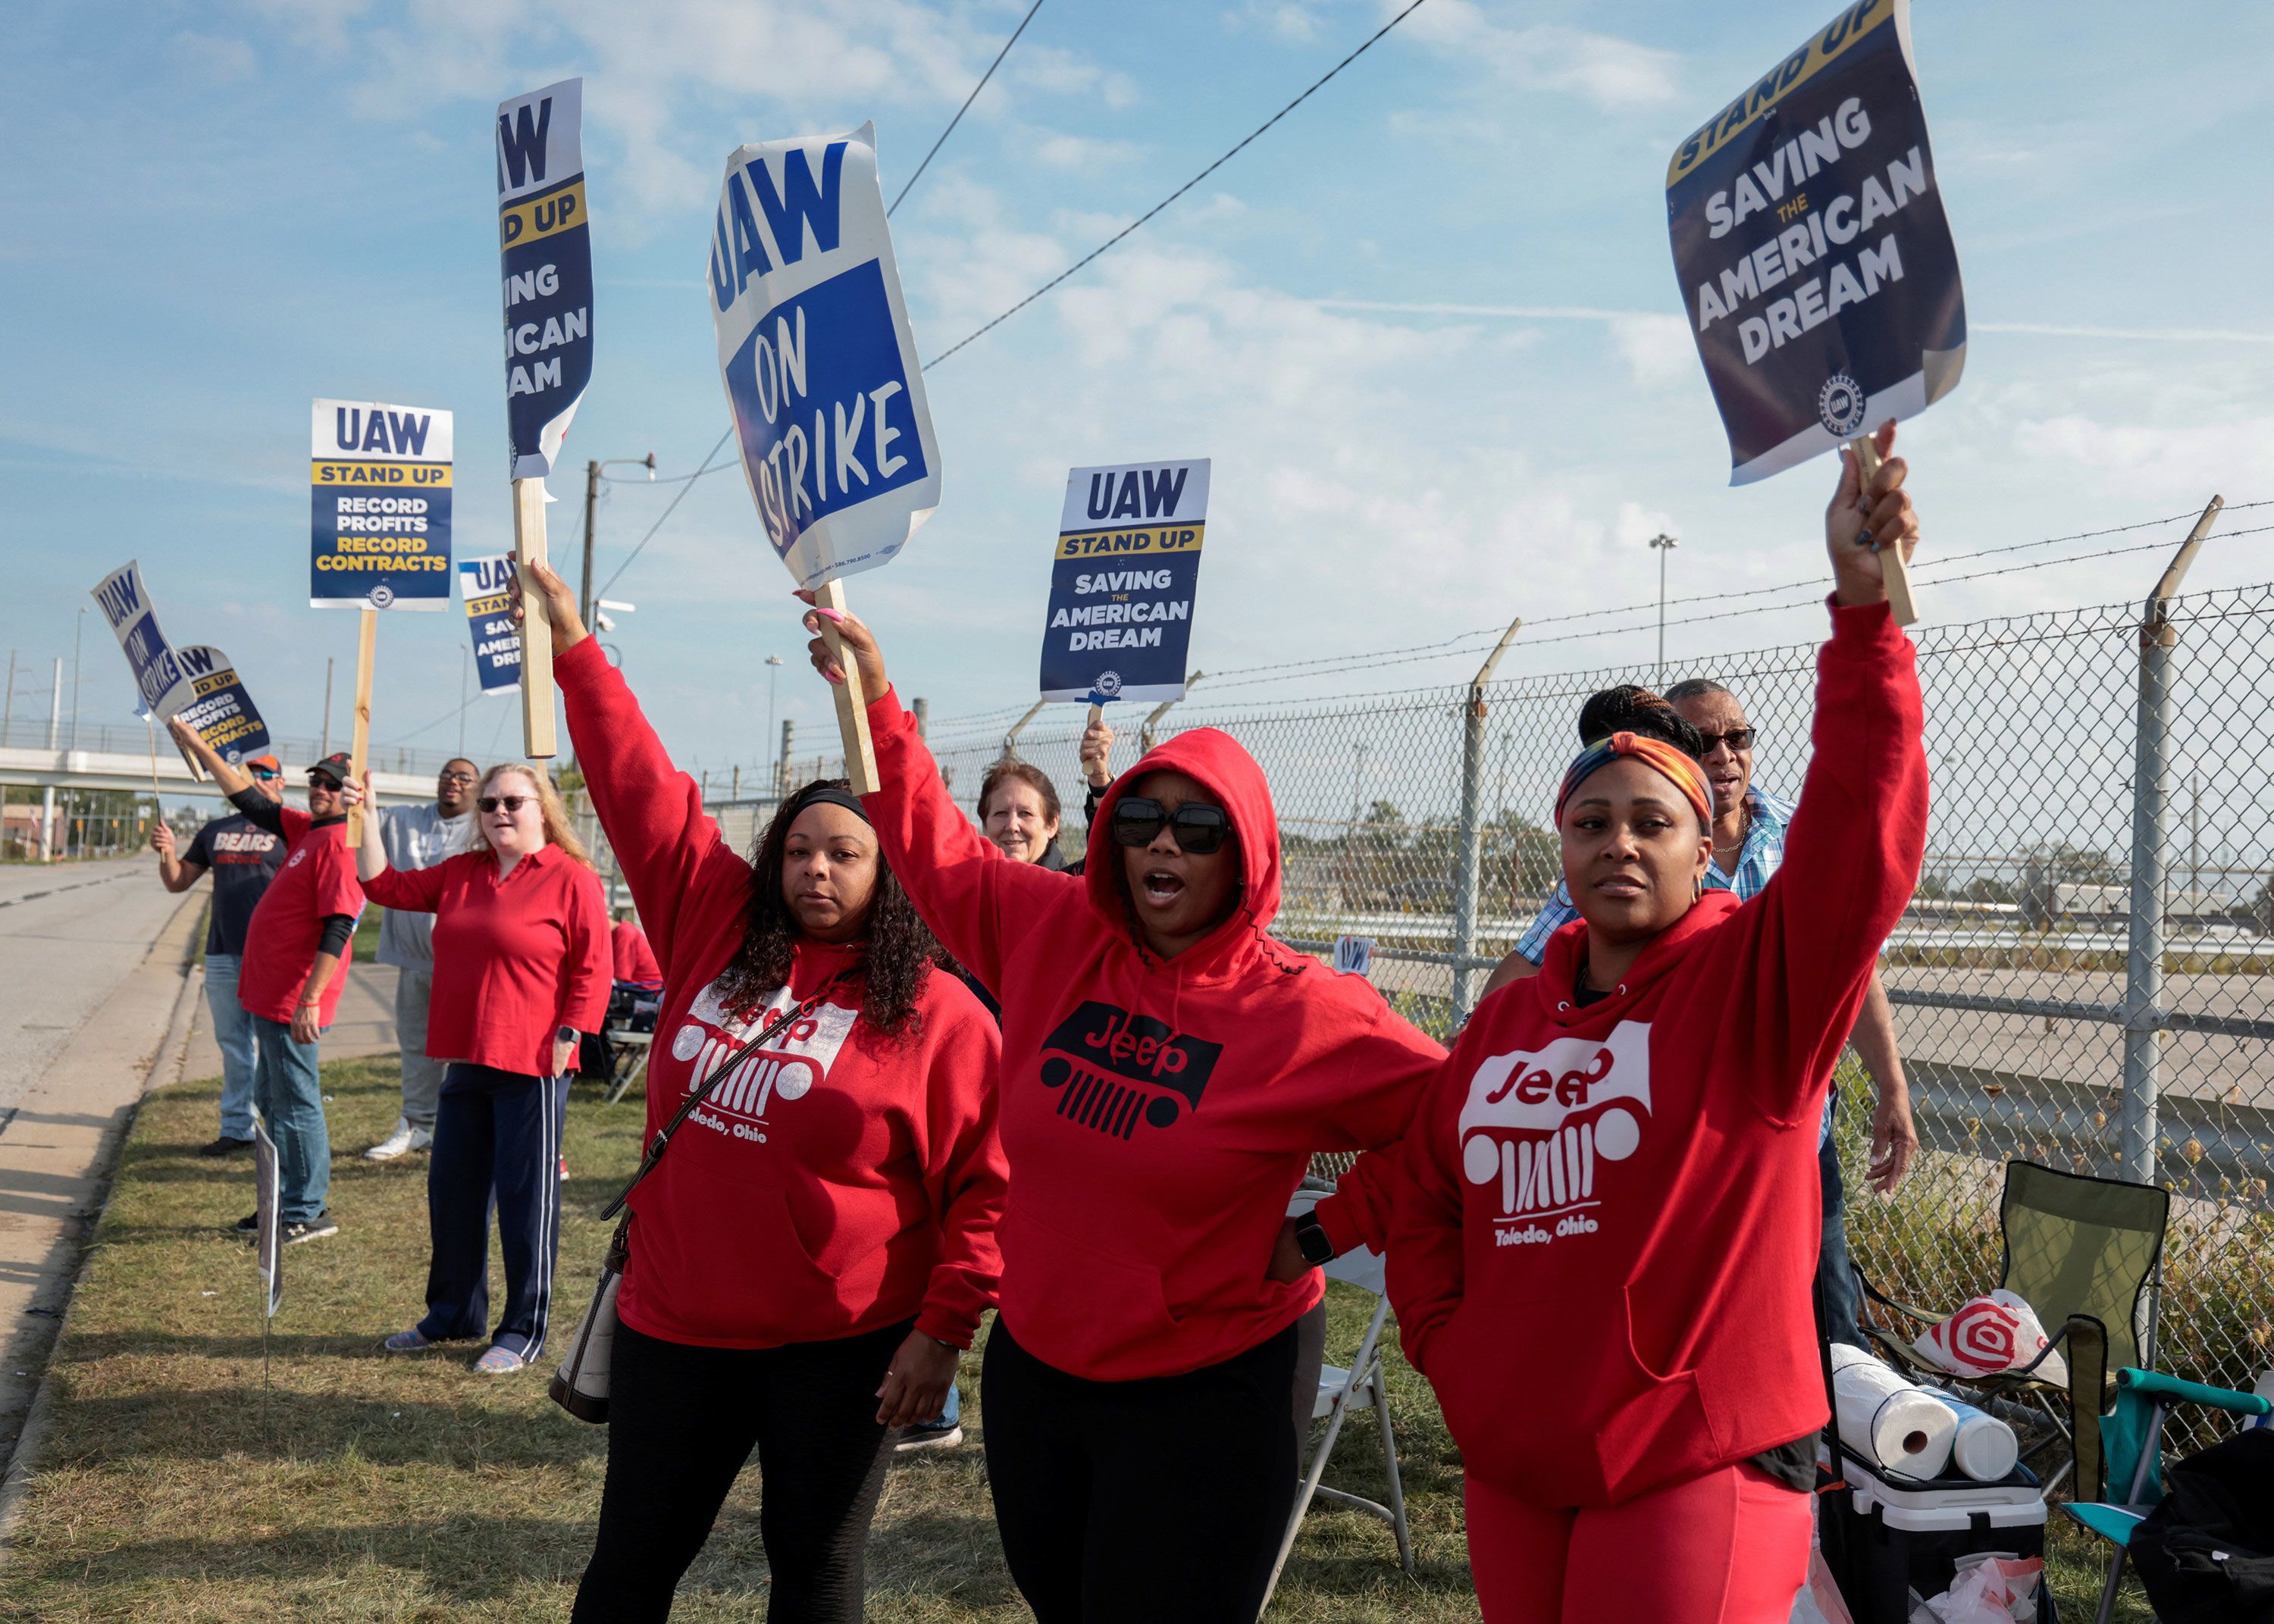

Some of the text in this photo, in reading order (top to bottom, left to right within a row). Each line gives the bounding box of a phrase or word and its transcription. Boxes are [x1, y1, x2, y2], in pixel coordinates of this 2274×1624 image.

[1677, 0, 1878, 171] STAND UP
[499, 96, 553, 194] W
[1705, 97, 1872, 239] SAVING
[534, 193, 576, 233] UP
[712, 142, 848, 313] UAW
[1777, 192, 1809, 224] THE
[1699, 146, 1928, 332] AMERICAN
[1737, 233, 1905, 366] DREAM
[504, 307, 587, 359] ICAN
[507, 357, 562, 398] AM
[754, 305, 806, 424] ON
[1830, 395, 1849, 414] UAW
[336, 407, 431, 456] UAW
[321, 465, 444, 484] STAND UP
[760, 380, 908, 547] STRIKE
[337, 497, 428, 515] RECORD
[1087, 468, 1189, 520] UAW
[337, 515, 429, 533] PROFITS
[1063, 530, 1195, 555] STAND UP
[315, 554, 447, 572] CONTRACTS
[337, 536, 428, 553] RECORD
[835, 553, 871, 568] 586.790.8500
[475, 559, 516, 590] UA
[1075, 569, 1172, 595] SAVING
[98, 570, 139, 628] UAW
[1051, 600, 1189, 628] AMERICAN
[1111, 593, 1129, 602] THE
[130, 627, 149, 666] ON
[1069, 627, 1163, 652] DREAM
[141, 649, 178, 706] STRIKE
[215, 674, 233, 686] UP
[179, 693, 234, 723] RECORD
[213, 832, 277, 852] BEARS
[1085, 1015, 1188, 1077] Jeep
[1486, 1047, 1615, 1108] Jeep
[681, 1102, 767, 1144] oledo, Ohio
[1495, 1214, 1599, 1247] Toledo, Ohio
